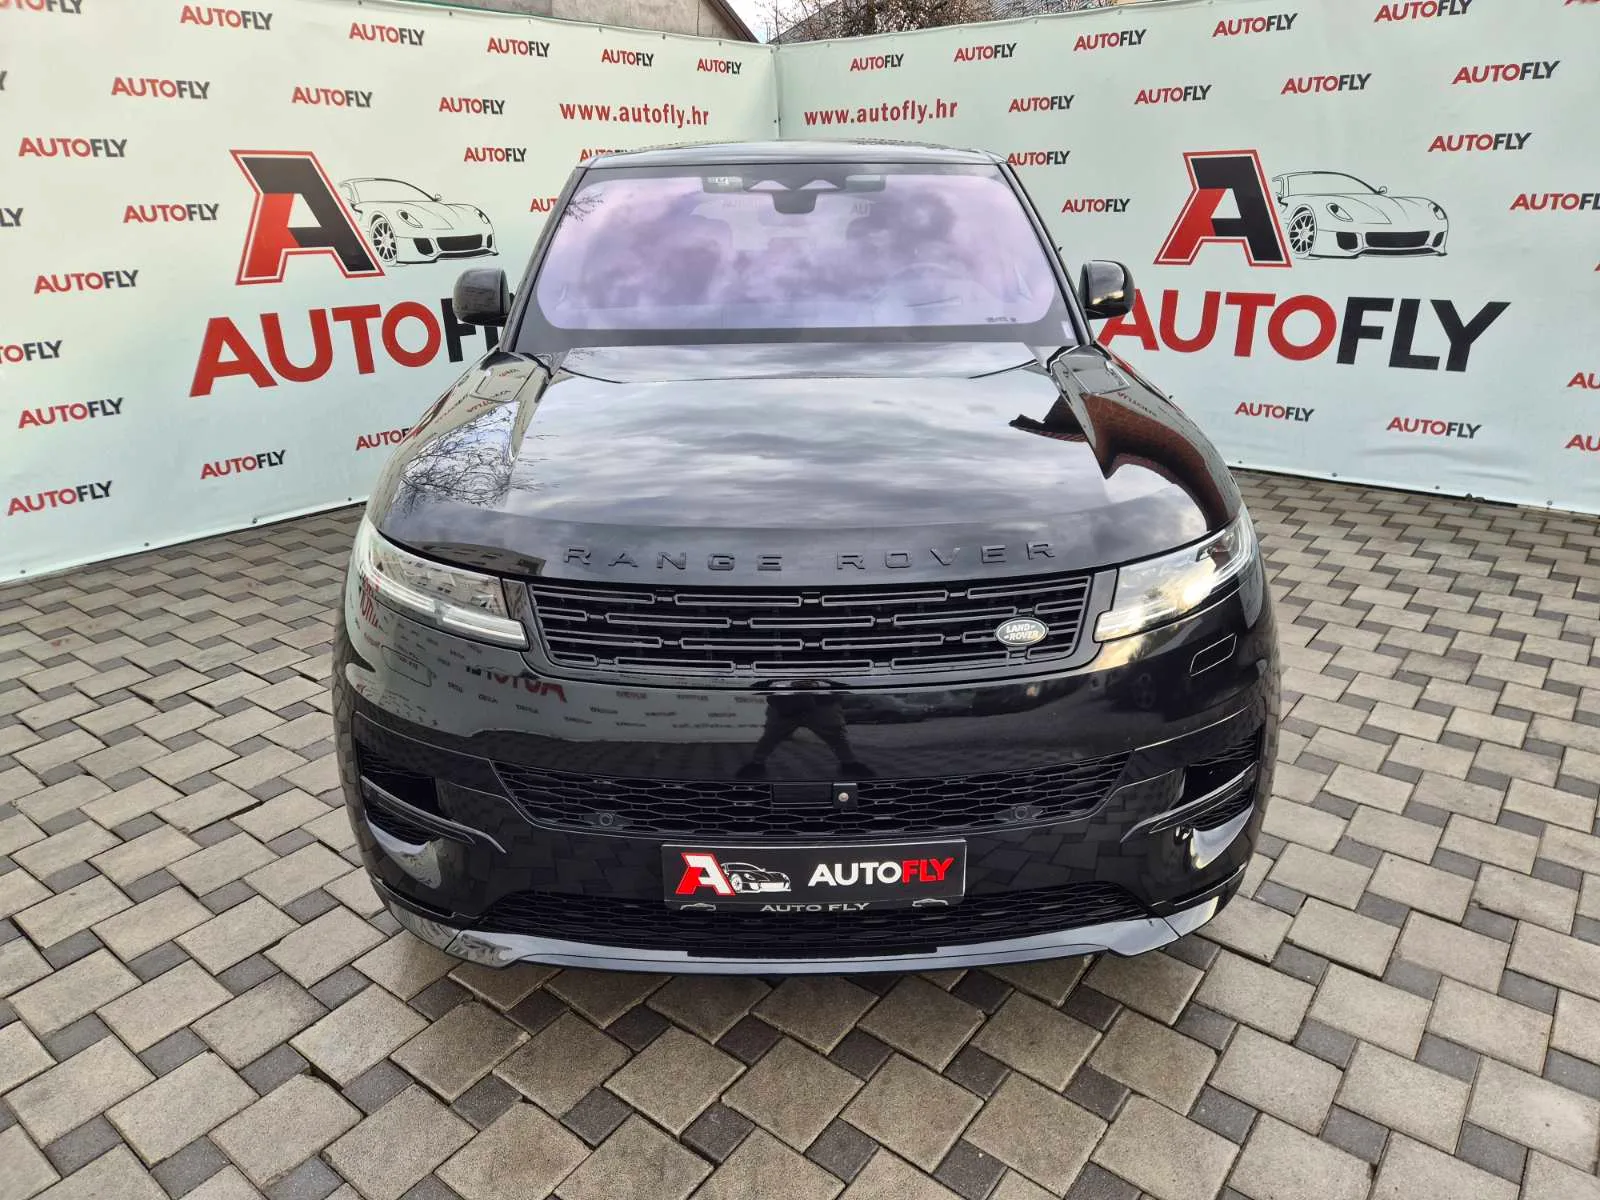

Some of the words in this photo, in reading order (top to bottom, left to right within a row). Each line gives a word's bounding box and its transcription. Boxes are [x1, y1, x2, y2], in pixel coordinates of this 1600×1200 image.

[181, 6, 272, 30] AUTOFLY
[1374, 0, 1472, 22] AUTOFLY
[349, 23, 424, 46] AUTOFLY
[1212, 13, 1298, 37] AUTOFLY
[487, 38, 550, 57] AUTOFLY
[1074, 29, 1146, 51] AUTOFLY
[602, 49, 654, 67] AUTOFLY
[850, 54, 904, 71] AUTOFLY
[954, 43, 1017, 62] AUTOFLY
[697, 58, 742, 74] AUTOFLY
[1452, 61, 1560, 84] AUTOFLY
[112, 77, 210, 99] AUTOFLY
[1281, 73, 1372, 94] AUTOFLY
[292, 87, 372, 108] AUTOFLY
[1009, 95, 1075, 112] AUTOFLY
[1134, 85, 1212, 104] AUTOFLY
[439, 97, 505, 115] AUTOFLY
[560, 104, 708, 128] www.autofly.hr
[804, 99, 957, 125] www.autofly.hr
[19, 138, 127, 157] AUTOFLY
[1428, 133, 1532, 152] AUTOFLY
[464, 147, 527, 162] AUTOFLY
[1007, 151, 1070, 166] AUTOFLY
[123, 204, 219, 223] AUTOFLY
[1062, 199, 1130, 213] AUTOFLY
[34, 270, 138, 294] AUTOFLY
[1097, 288, 1511, 372] AUTOFLY
[0, 340, 62, 364] OFLY
[19, 397, 124, 428] AUTOFLY
[1235, 402, 1314, 422] AUTOFLY
[1387, 417, 1482, 439] AUTOFLY
[201, 450, 285, 479] AUTOFLY
[8, 480, 112, 516] AUTOFLY
[564, 547, 782, 571] RANGE
[837, 541, 1055, 570] ROVER
[808, 857, 954, 887] AUTOFLY
[760, 904, 822, 912] AUTO
[828, 902, 870, 912] FLY
